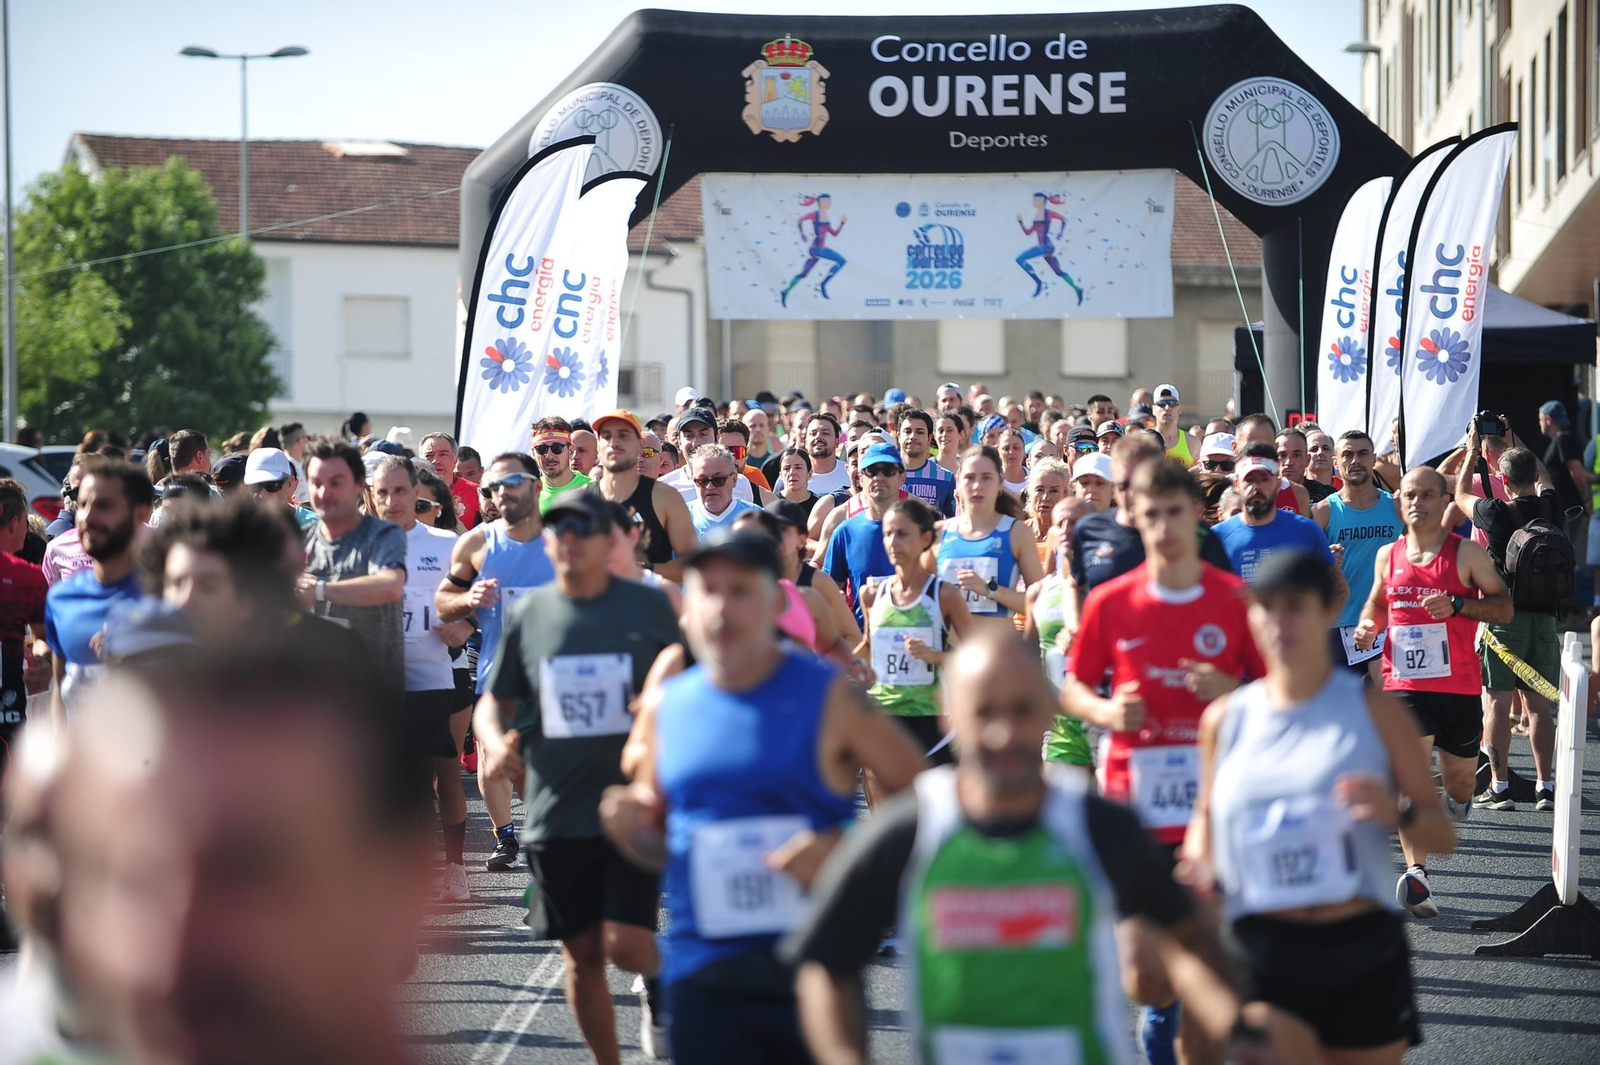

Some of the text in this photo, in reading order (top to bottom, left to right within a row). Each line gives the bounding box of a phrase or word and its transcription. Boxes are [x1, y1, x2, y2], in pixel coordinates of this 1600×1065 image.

[870, 33, 1088, 62] Concello de
[868, 71, 1127, 117] OURENSE
[622, 102, 641, 119] DE
[635, 119, 653, 171] DEPORT
[949, 131, 1048, 151] Deportes
[1212, 85, 1330, 179] CONSELLO MUNICIPAL DE DEPORTES
[1247, 181, 1302, 199] OURENSE
[935, 209, 977, 217] OURENSE
[906, 270, 963, 289] 2026
[1420, 242, 1465, 319] chc
[1461, 245, 1483, 322] energía
[487, 253, 535, 330] chc
[1331, 265, 1358, 329] chc
[899, 484, 937, 498] OCTURNA
[1338, 525, 1395, 541] AFIADORES
[1415, 586, 1448, 598] TEAM
[887, 654, 909, 674] 84
[1406, 649, 1427, 669] 92
